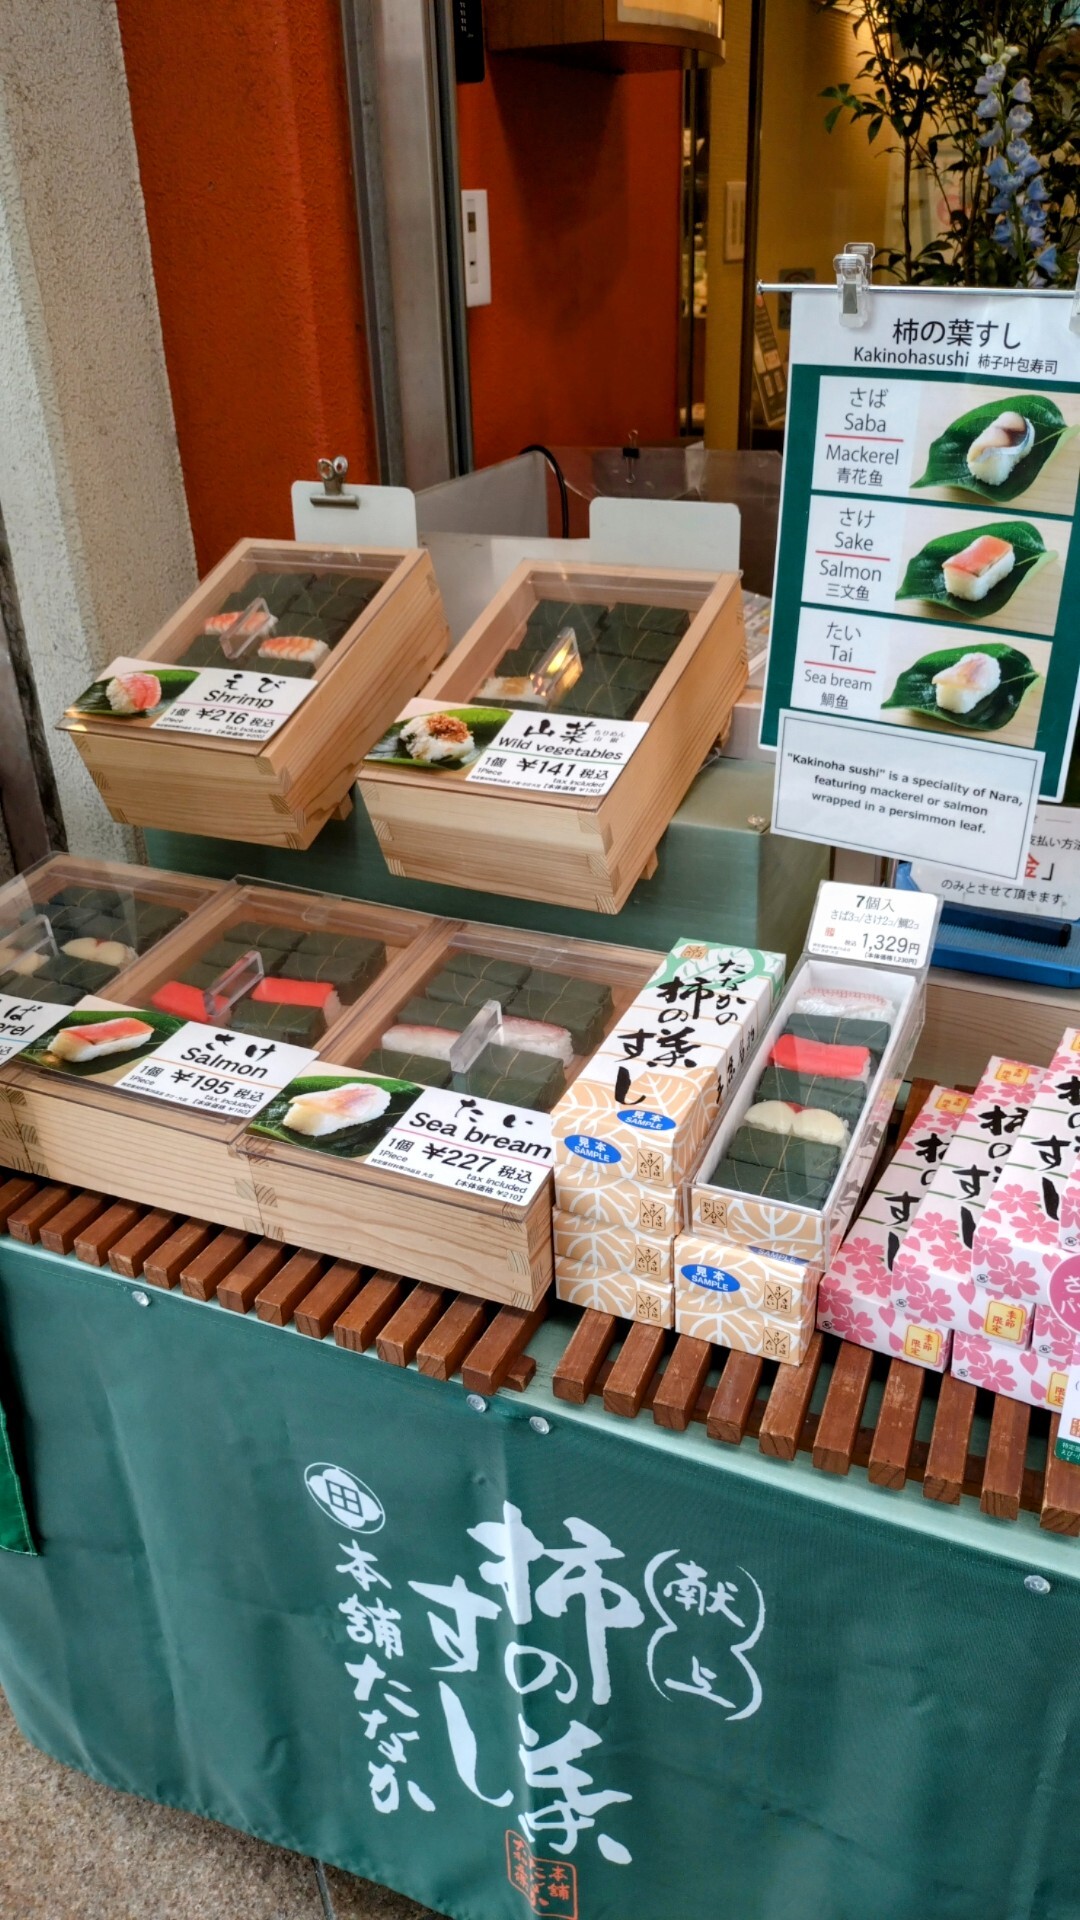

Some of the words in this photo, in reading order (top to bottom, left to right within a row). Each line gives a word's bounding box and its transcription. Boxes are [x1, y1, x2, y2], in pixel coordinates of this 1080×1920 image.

[892, 318, 1021, 350] 柿の葉すし
[853, 346, 969, 368] Kakinohasushi
[849, 387, 888, 408] さば
[844, 412, 886, 433] Saba
[825, 444, 899, 466] Mackerel
[839, 507, 875, 528] さけ
[834, 531, 874, 551] Sake
[819, 559, 882, 582] Salmon
[826, 622, 861, 641] たい
[830, 644, 853, 663] Tai
[224, 673, 286, 694] えび
[804, 669, 827, 685] Sea
[830, 672, 872, 691] bream
[203, 689, 275, 710] Shrimp
[196, 708, 249, 726] ¥216
[523, 718, 596, 744] 山菜
[499, 736, 532, 750] Wild
[536, 743, 623, 760] vegetables
[484, 756, 507, 768] 1個
[516, 757, 577, 778] ¥141
[579, 768, 609, 781] 税込
[787, 752, 846, 772] "Kakinoha
[848, 764, 886, 779] sushi"
[888, 770, 899, 782] is
[901, 774, 909, 784] a
[912, 775, 970, 798] speciality
[972, 786, 987, 798] of
[989, 789, 1024, 807] Nara,
[552, 777, 567, 786] tax
[569, 778, 605, 788] included
[814, 774, 867, 795] featuring
[870, 784, 924, 804] mackerel
[927, 795, 941, 806] or
[943, 798, 988, 816] salmon
[812, 792, 861, 809] wrapped
[864, 801, 875, 812] in
[878, 804, 886, 814] a
[888, 805, 956, 828] persimmon
[959, 819, 987, 834] leaf.
[856, 894, 895, 913] 7個入
[941, 878, 1068, 908] のみとさせて頂きます。
[862, 932, 921, 956] 1,329円
[0, 999, 43, 1021] ば
[647, 975, 714, 1068] 柿の葉
[205, 1033, 276, 1060] さけ
[180, 1046, 269, 1080] Salmon
[614, 1028, 657, 1106] すし
[139, 1065, 165, 1078] 1個
[170, 1068, 235, 1096] ¥195
[234, 1086, 266, 1103] 税込
[204, 1093, 218, 1103] tax
[220, 1096, 257, 1110] included
[455, 1099, 533, 1129] たい
[624, 1116, 663, 1130] SAMPLE
[633, 1109, 663, 1123] 見本
[409, 1112, 456, 1137] Sea
[464, 1126, 552, 1160] bream
[577, 1135, 607, 1153] 見本
[387, 1137, 415, 1153] 1個
[421, 1142, 497, 1174] ¥227
[497, 1164, 533, 1185] 税込
[574, 1145, 611, 1163] SAMPLE
[378, 1148, 409, 1163] 1Piece
[466, 1172, 485, 1183] tax
[486, 1176, 528, 1195] included
[691, 1275, 729, 1291] SAMPLE
[695, 1266, 725, 1282] 見本
[335, 1539, 436, 1814] 本舗たなか
[466, 1500, 645, 1865] 柿の葉
[408, 1574, 515, 1808] すし
